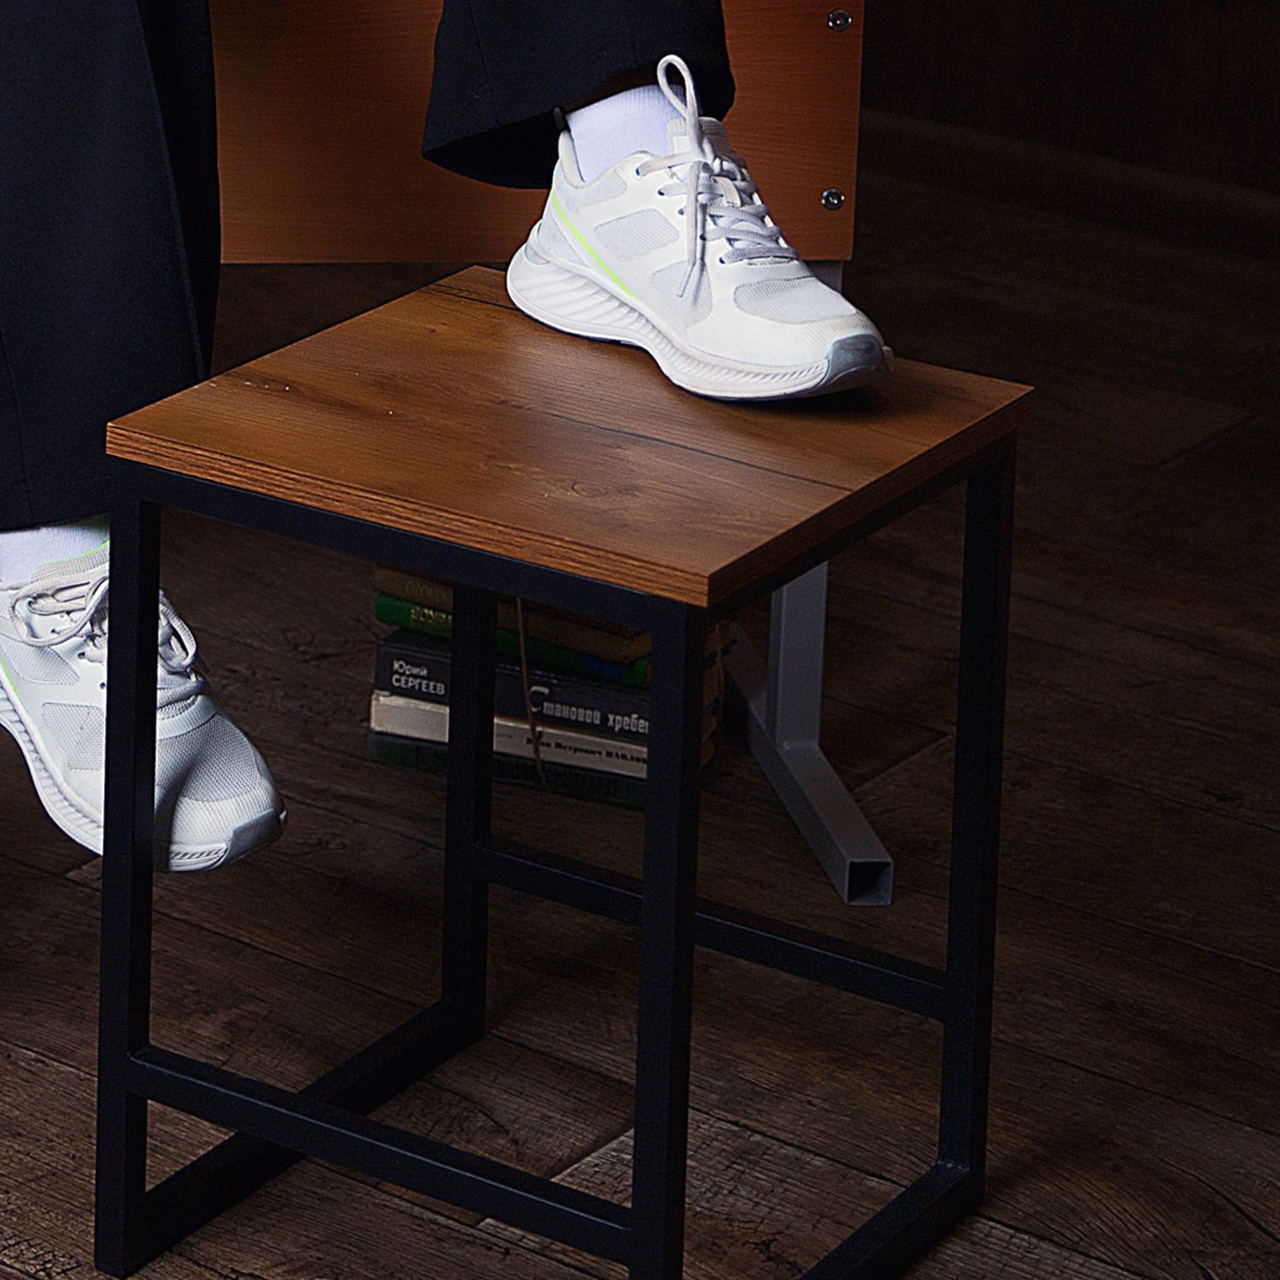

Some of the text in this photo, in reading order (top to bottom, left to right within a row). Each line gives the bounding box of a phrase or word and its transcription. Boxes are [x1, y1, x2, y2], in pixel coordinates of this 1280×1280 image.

[392, 658, 428, 679] Юрий
[391, 674, 447, 696] СЕРГЕЕВ
[529, 685, 601, 727] Становой
